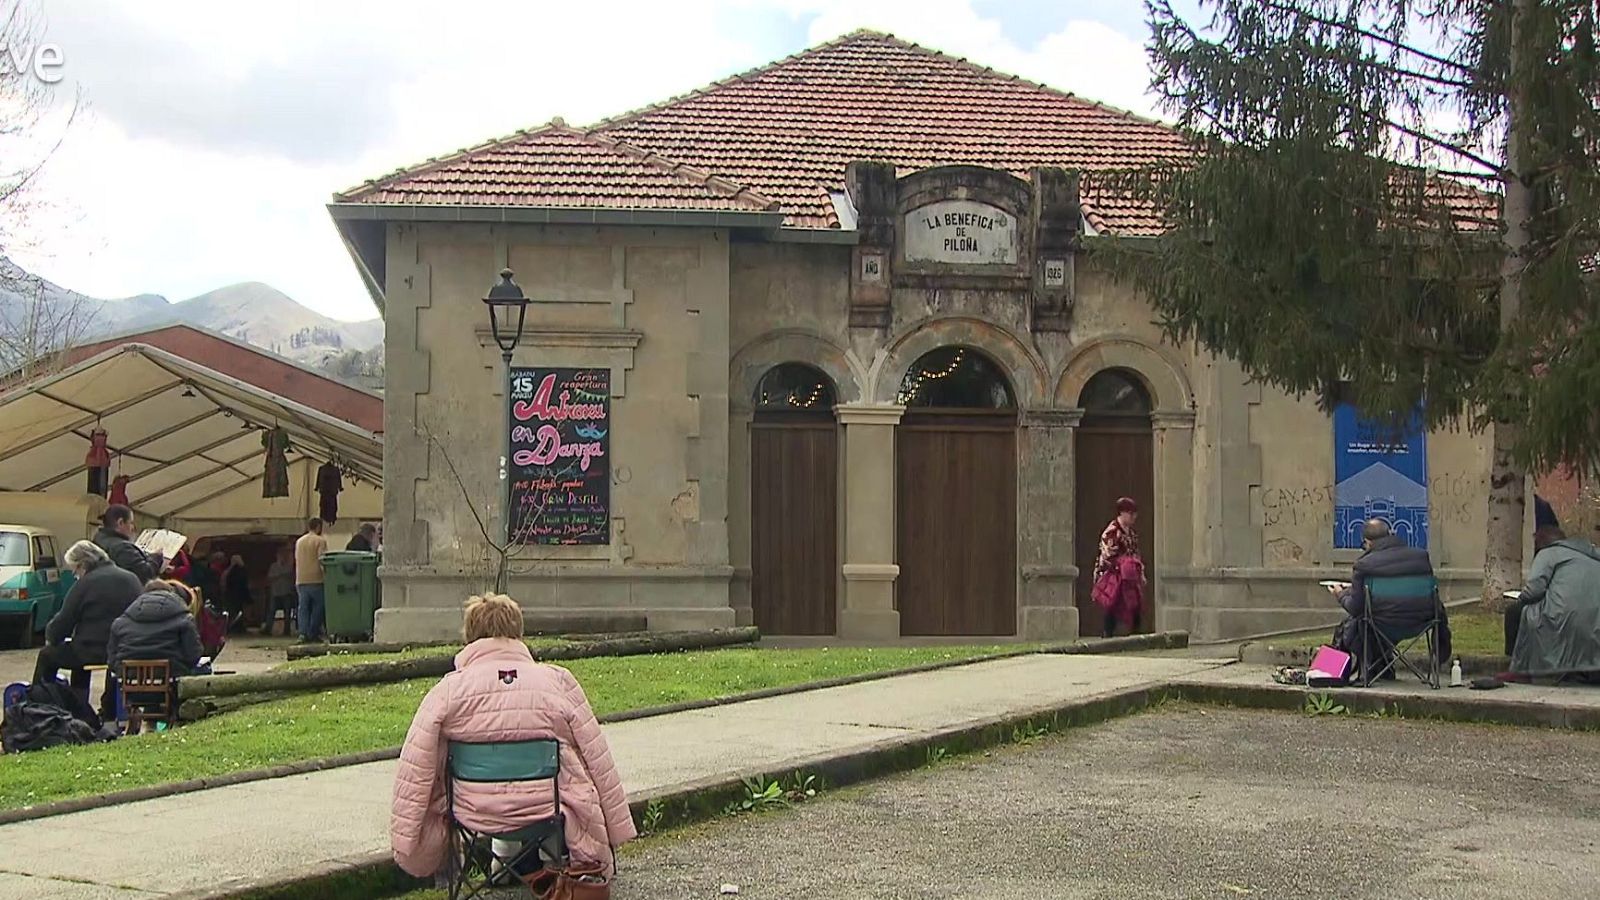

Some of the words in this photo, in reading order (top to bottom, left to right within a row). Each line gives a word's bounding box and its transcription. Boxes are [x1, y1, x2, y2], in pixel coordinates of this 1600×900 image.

[944, 213, 994, 231] BENEFICA
[956, 227, 966, 237] DE
[944, 238, 978, 252] PILOÑA
[865, 260, 878, 275] AÑO
[574, 371, 597, 381] Gran
[513, 378, 533, 393] 15
[560, 380, 607, 389] reapertura
[511, 425, 535, 443] en
[513, 424, 604, 471] Danza
